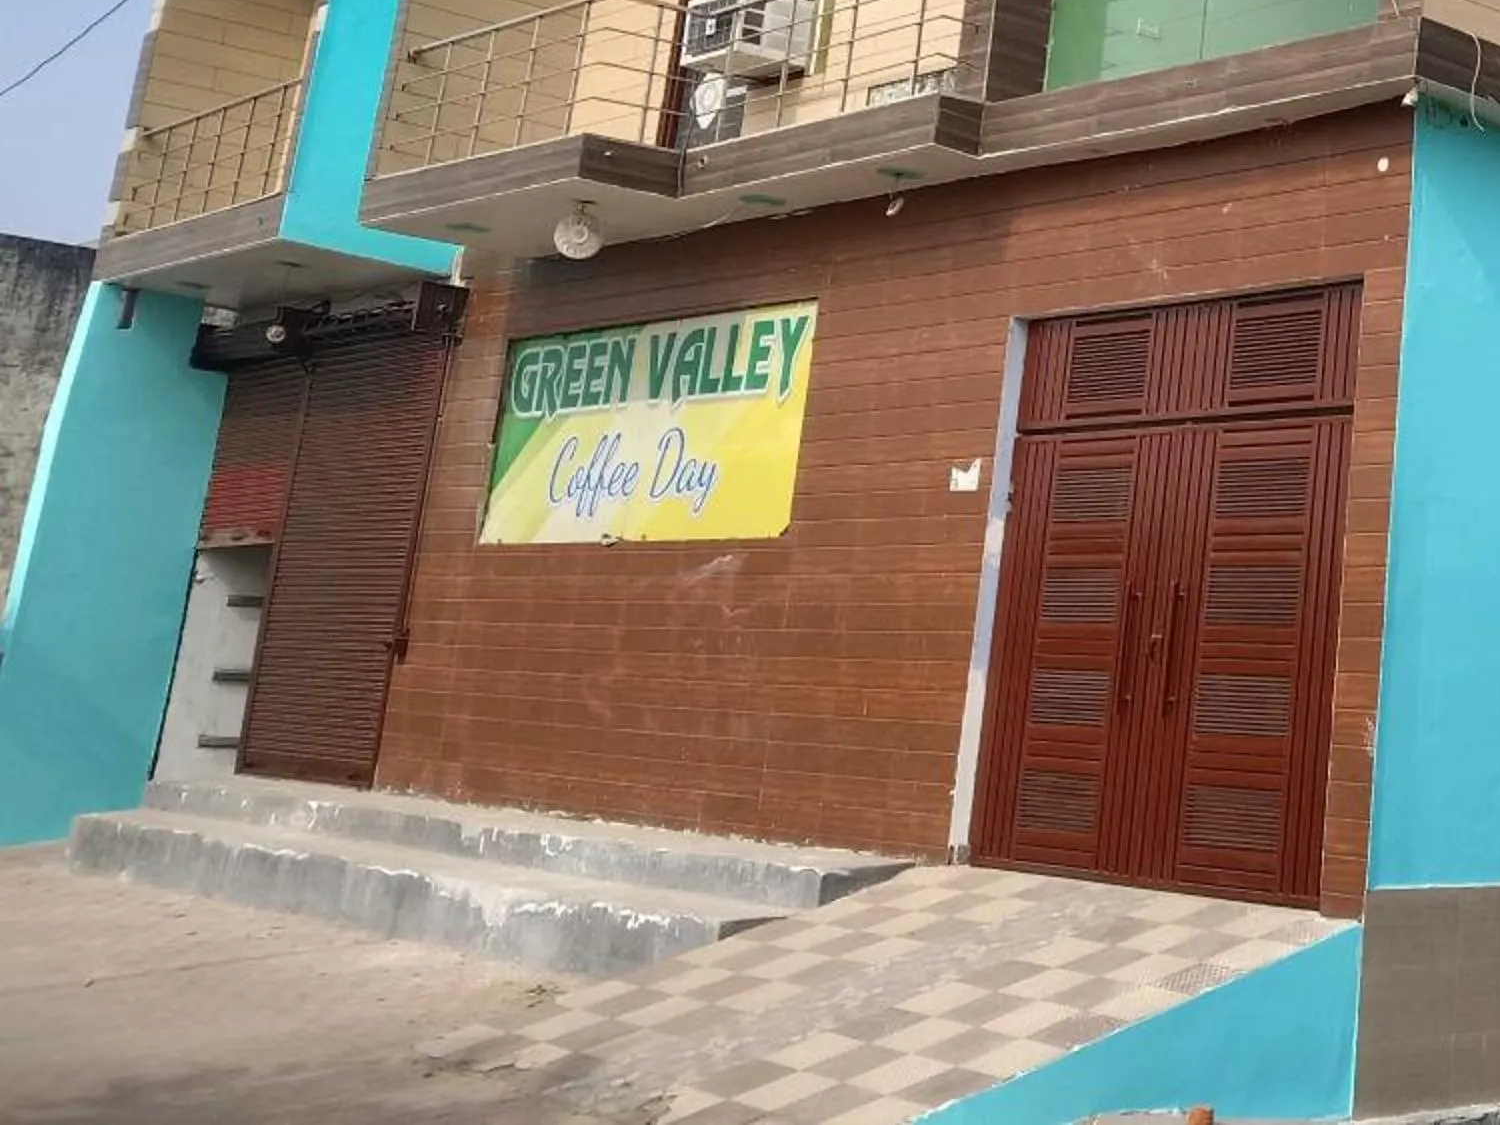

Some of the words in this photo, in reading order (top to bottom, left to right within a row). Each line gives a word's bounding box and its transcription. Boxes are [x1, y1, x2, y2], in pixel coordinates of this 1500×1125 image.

[512, 337, 637, 418] GREEN
[645, 315, 810, 403] VALLEY
[549, 433, 639, 517] Coffee
[650, 427, 717, 513] Day
